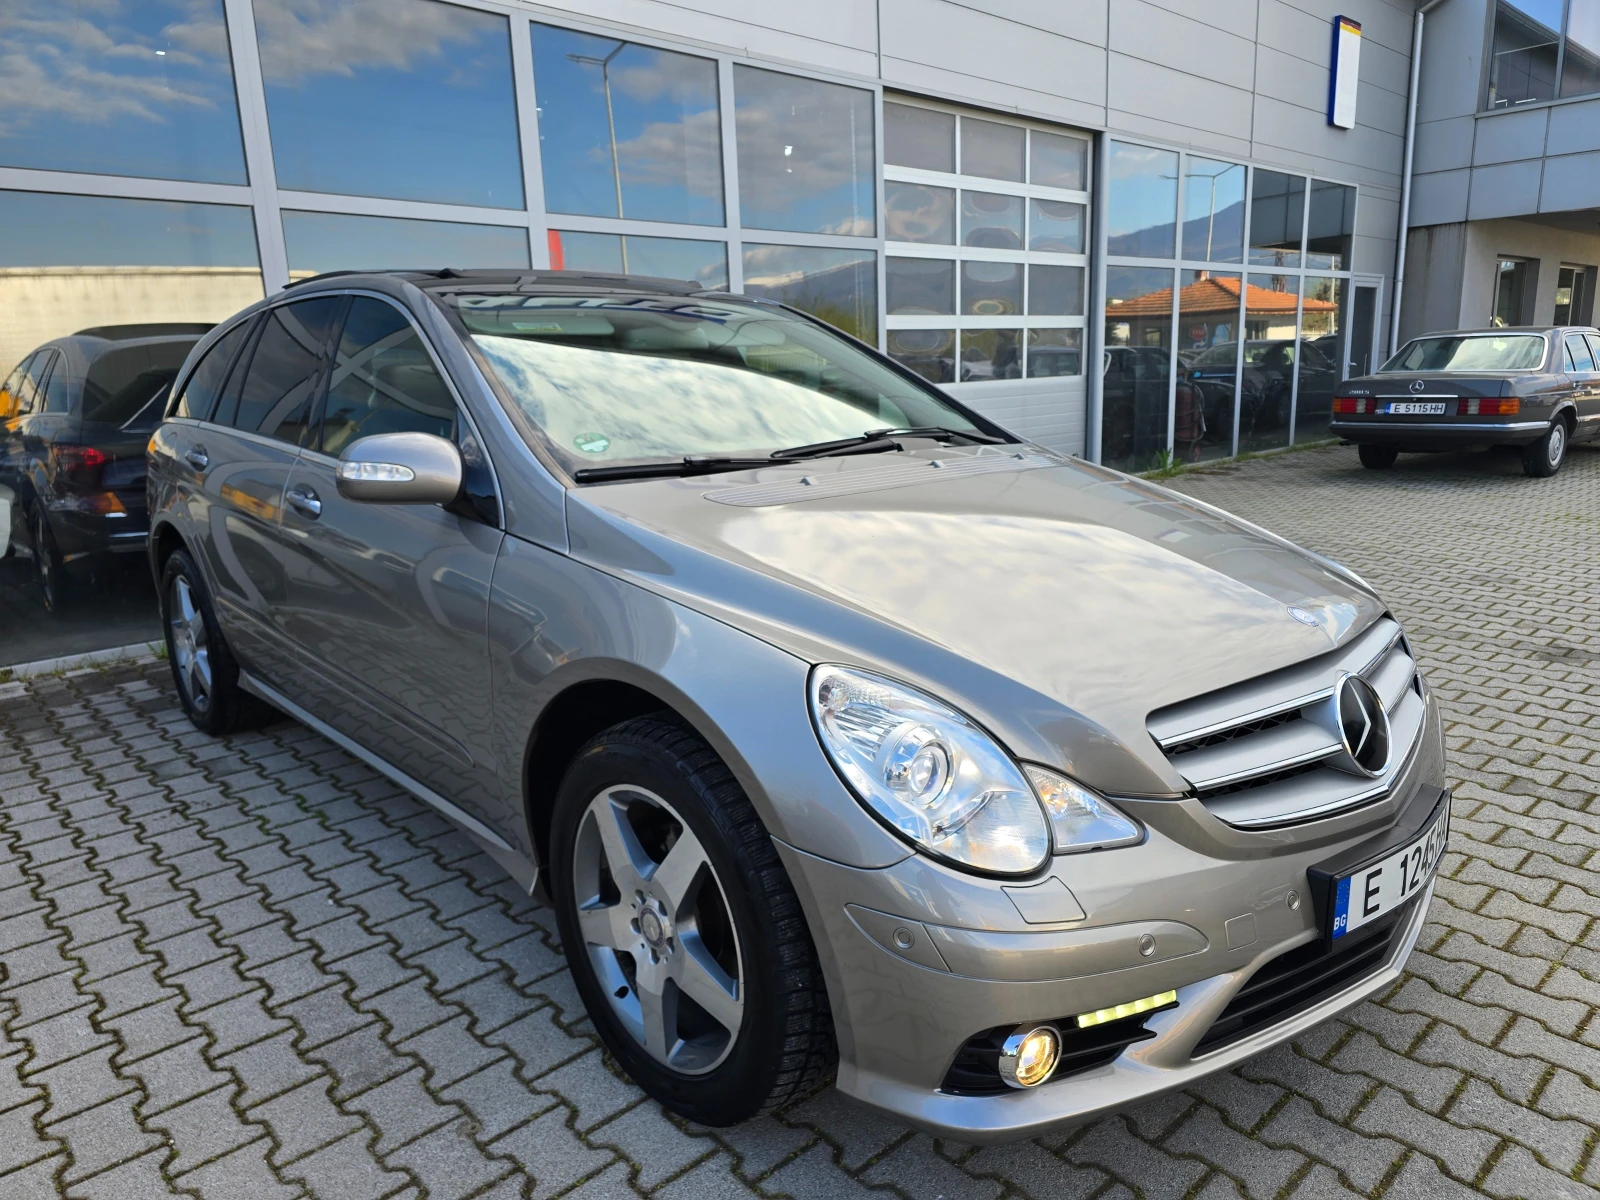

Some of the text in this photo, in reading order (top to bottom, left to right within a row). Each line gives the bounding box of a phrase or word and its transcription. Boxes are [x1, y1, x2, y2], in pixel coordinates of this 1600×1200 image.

[1394, 404, 1400, 412] E
[1362, 867, 1383, 918] E
[1333, 913, 1347, 931] BG
